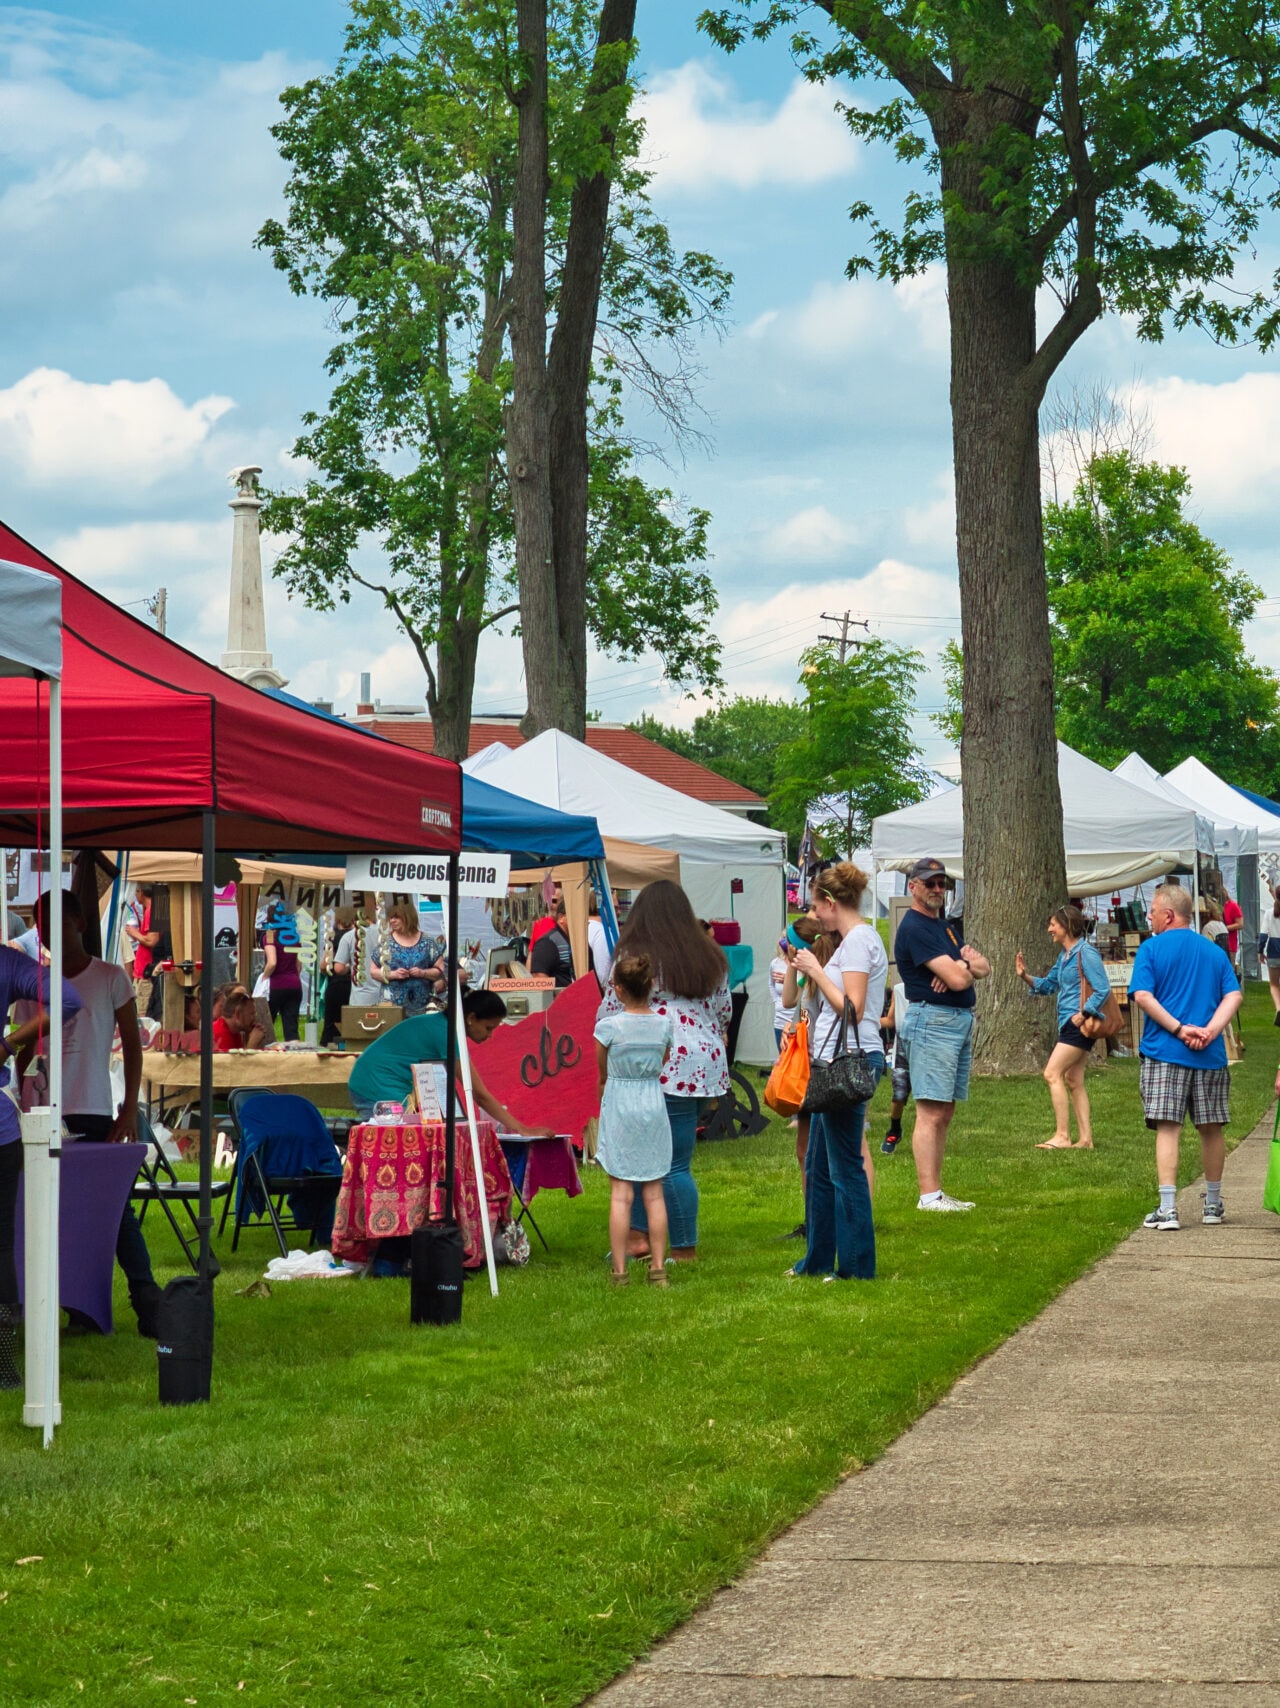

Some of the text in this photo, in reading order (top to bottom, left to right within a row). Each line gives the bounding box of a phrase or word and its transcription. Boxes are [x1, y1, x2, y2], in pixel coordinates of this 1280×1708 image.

[422, 807, 452, 828] CRAFTSMAN
[490, 981, 554, 989] WOODOHIO.COM
[521, 1025, 582, 1088] cle
